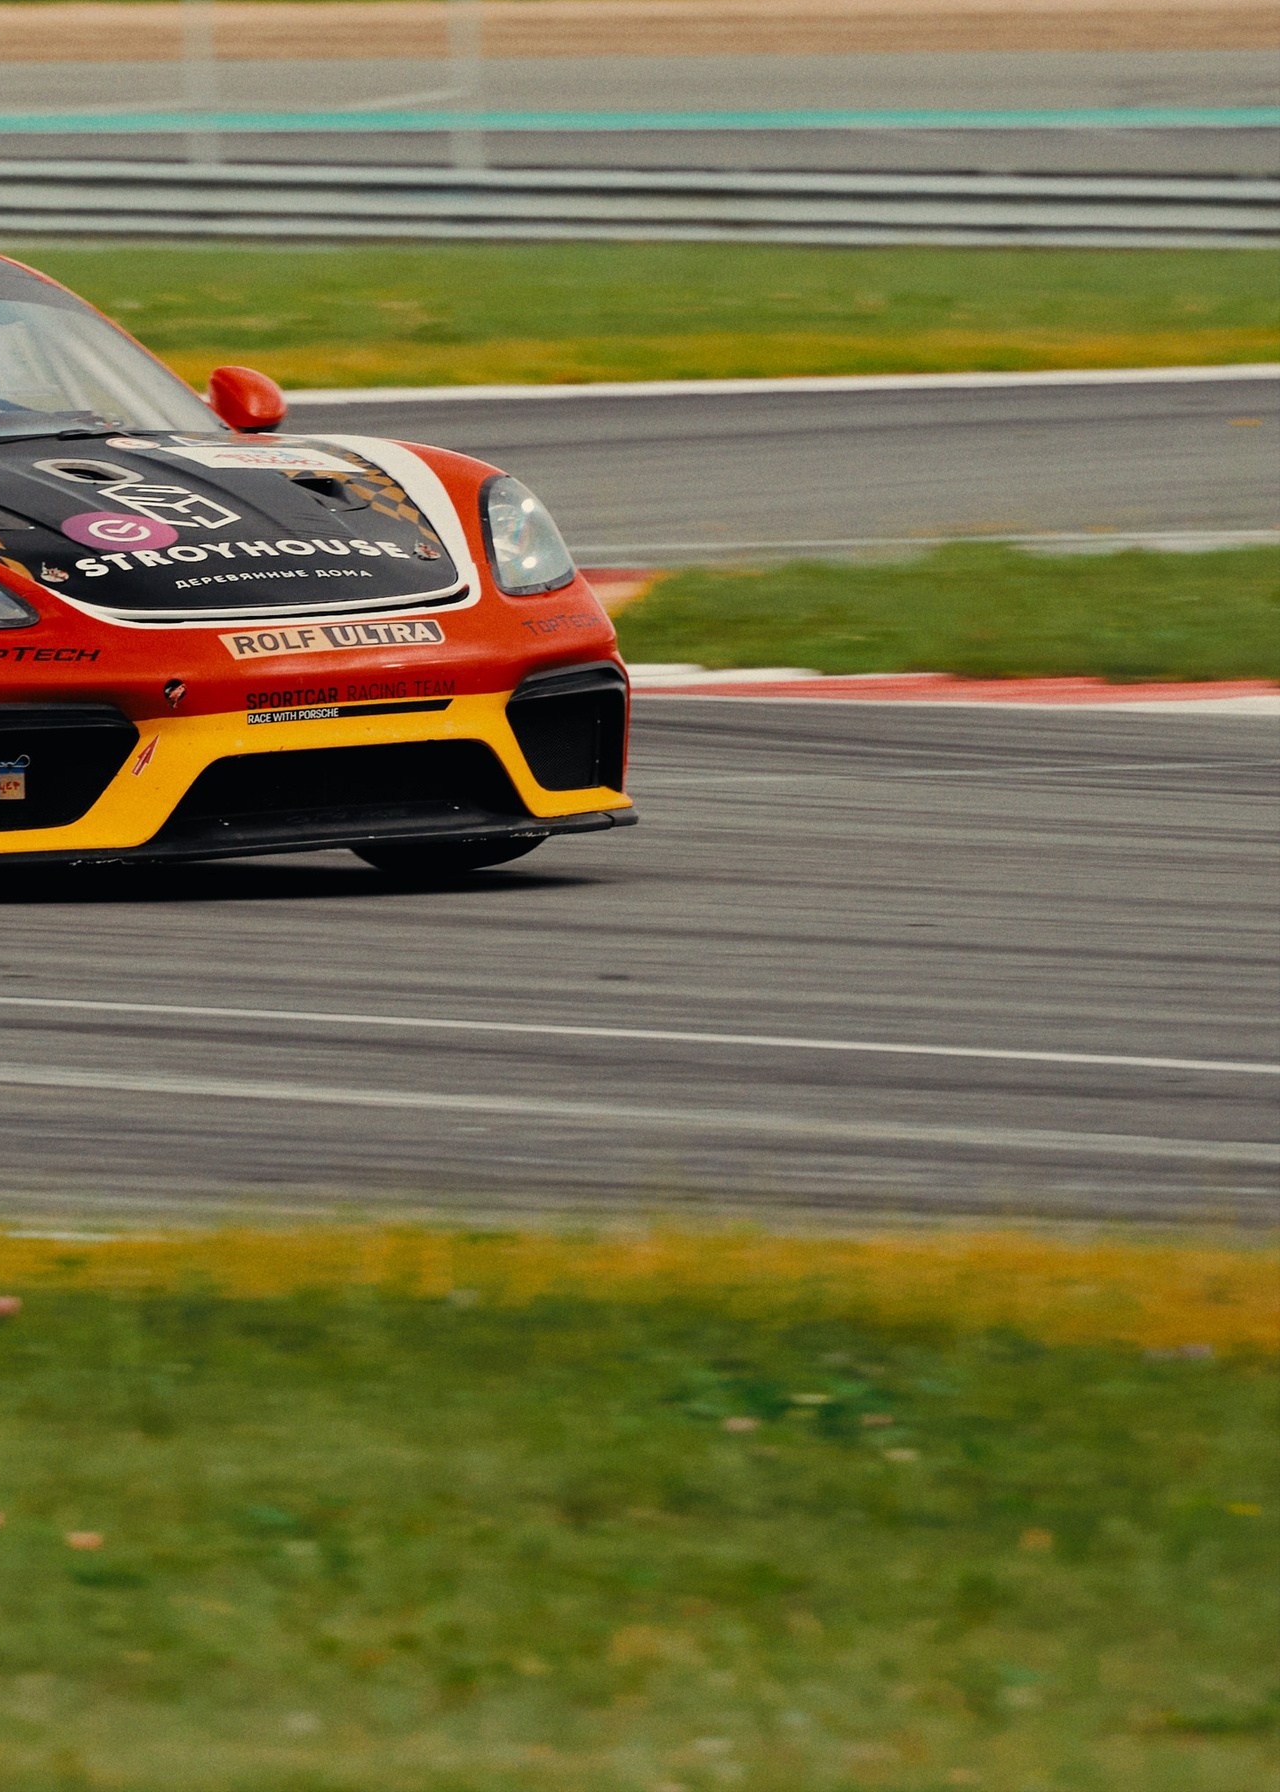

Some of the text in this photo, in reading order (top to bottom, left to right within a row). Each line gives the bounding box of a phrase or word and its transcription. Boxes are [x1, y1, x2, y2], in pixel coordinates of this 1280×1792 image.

[75, 539, 411, 577] STROYHOUSE
[175, 569, 373, 589] ДЕРЕВЯННЫЕ ДОМА
[233, 623, 438, 655] ROLF ULTRA
[246, 679, 455, 710] SPORTCAR RACING TEAM
[247, 707, 339, 724] RACE WITH PORSCHE
